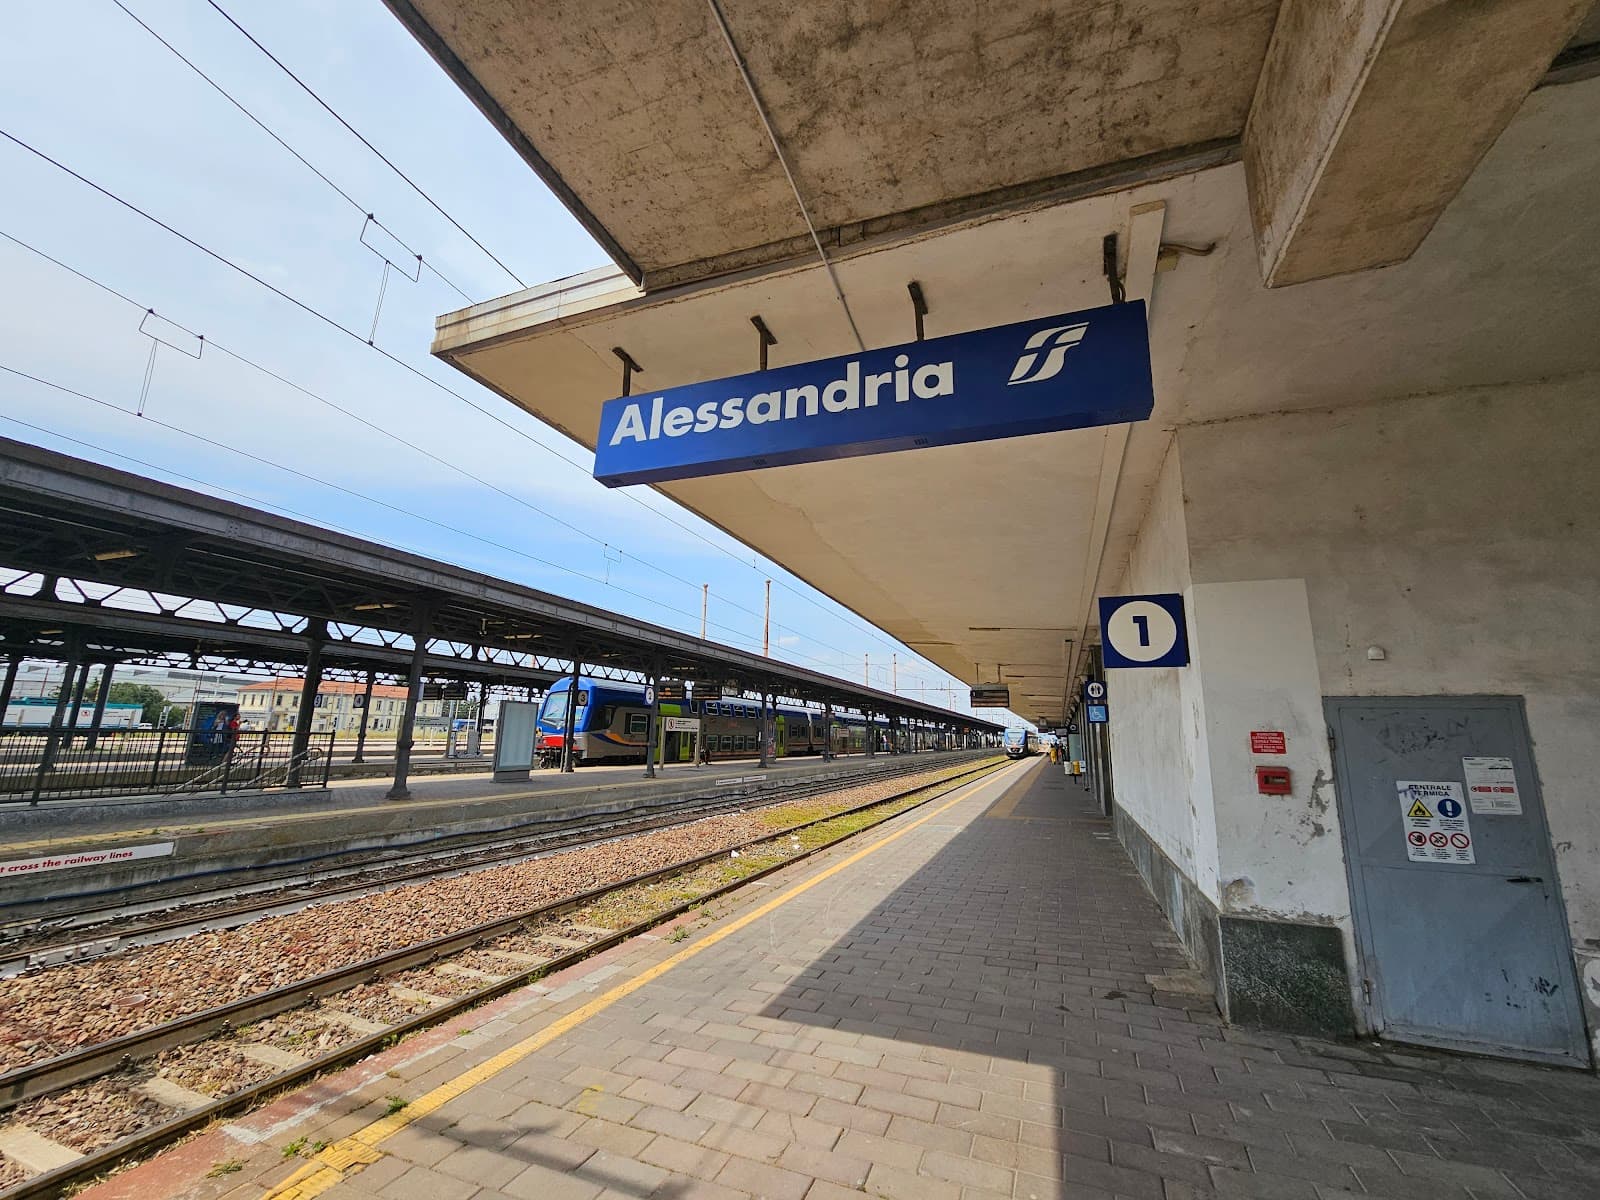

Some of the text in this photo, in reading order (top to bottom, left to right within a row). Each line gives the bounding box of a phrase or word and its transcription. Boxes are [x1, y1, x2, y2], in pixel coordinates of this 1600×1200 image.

[609, 354, 954, 446] Alessandria
[1132, 615, 1150, 647] 1
[8, 863, 39, 872] cross
[42, 859, 61, 868] the
[64, 853, 107, 865] railway
[109, 850, 134, 859] lines
